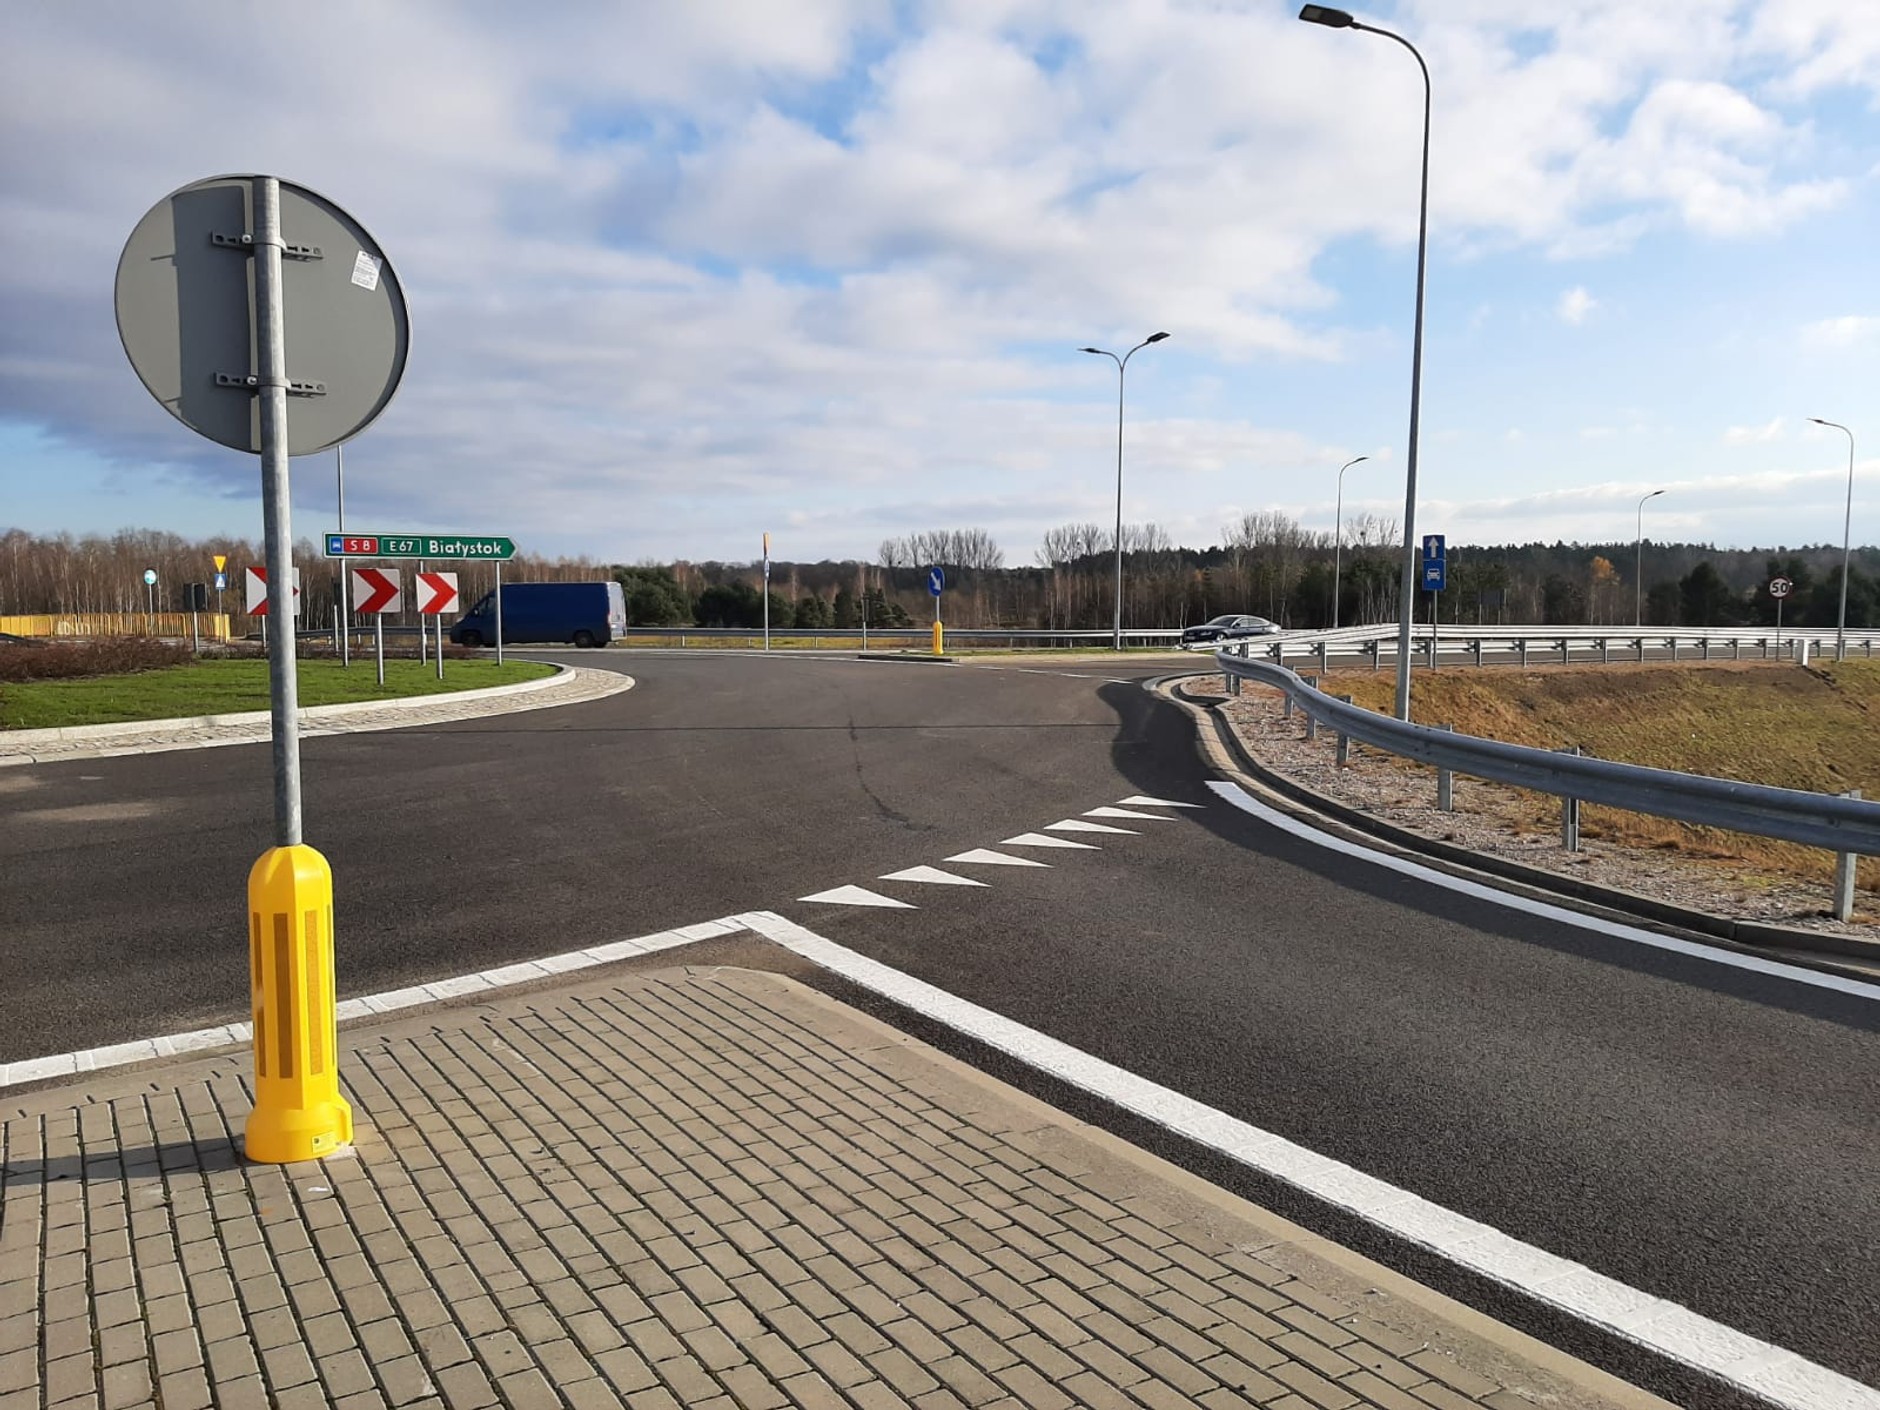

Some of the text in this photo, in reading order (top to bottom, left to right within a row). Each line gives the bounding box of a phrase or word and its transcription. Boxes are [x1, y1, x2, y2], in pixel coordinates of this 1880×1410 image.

[351, 540, 358, 551] S
[429, 540, 502, 557] Białystok
[1772, 582, 1788, 593] 50
